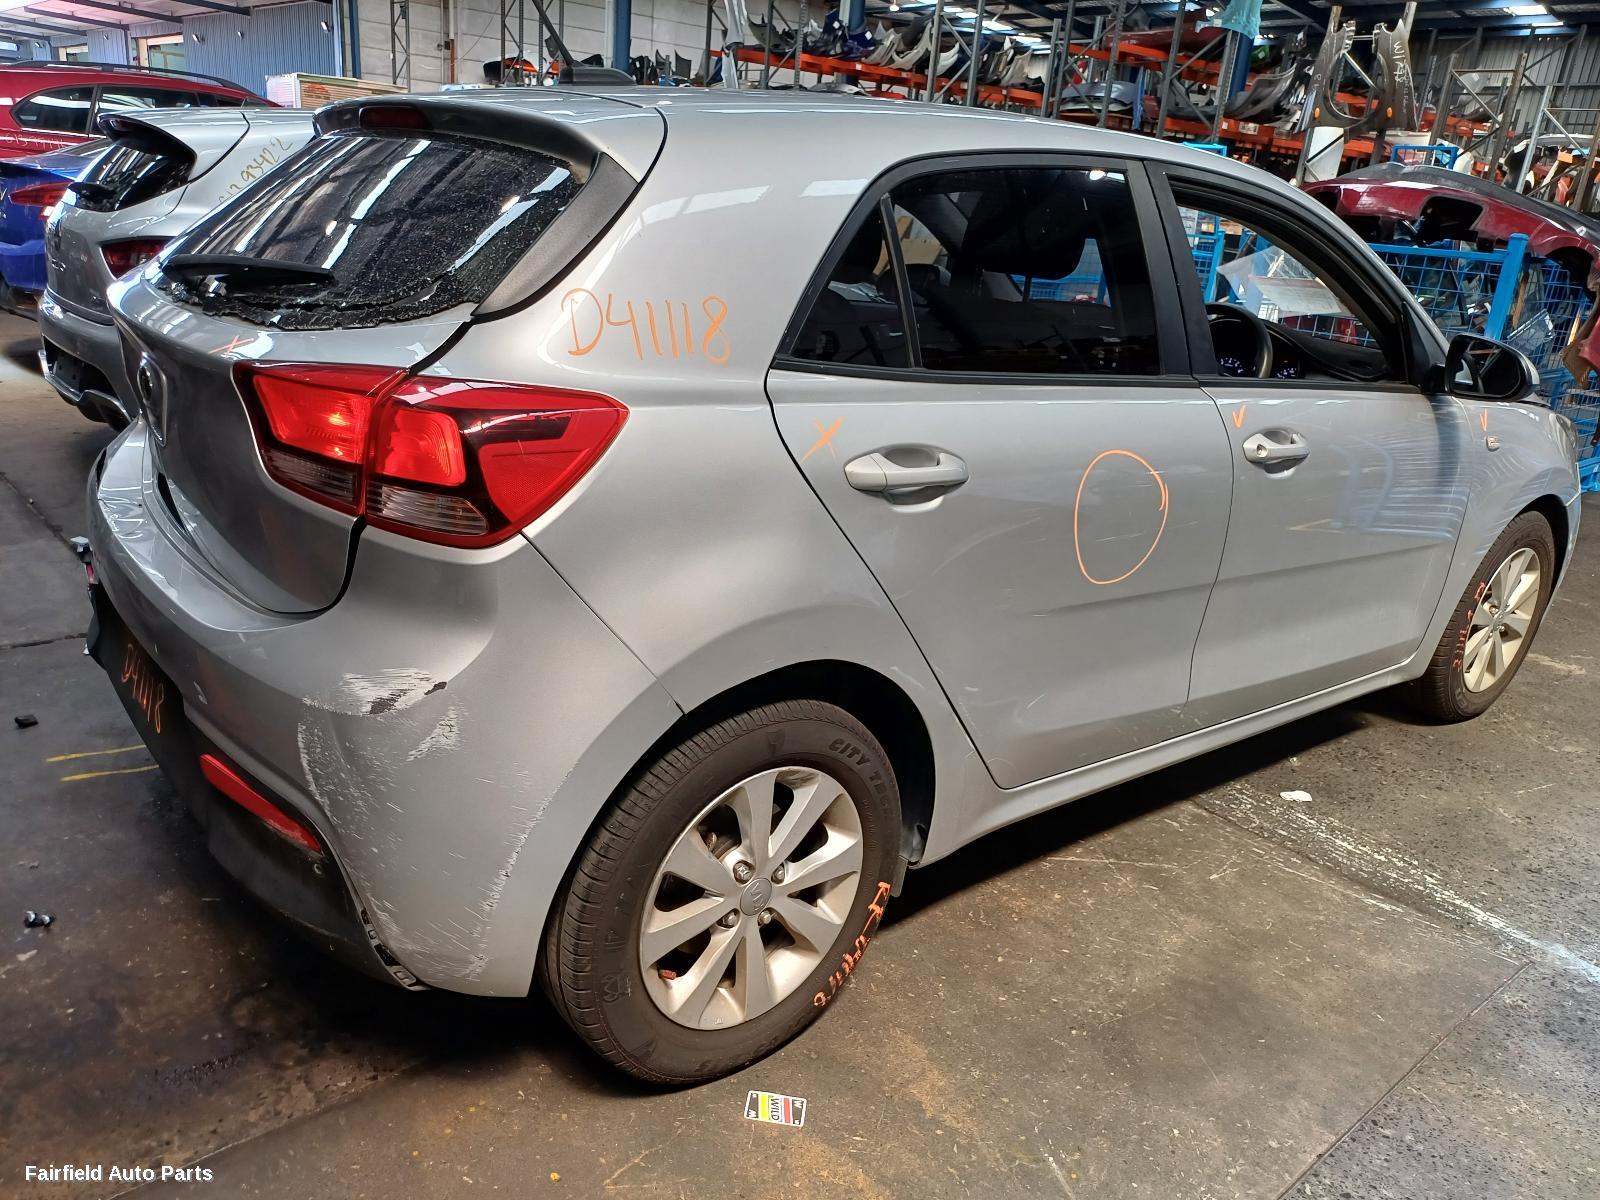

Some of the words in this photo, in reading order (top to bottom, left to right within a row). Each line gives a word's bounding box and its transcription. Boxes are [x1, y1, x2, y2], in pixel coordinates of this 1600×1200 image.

[561, 287, 732, 365] D41118
[828, 738, 871, 766] CITY
[770, 1098, 780, 1121] WILD
